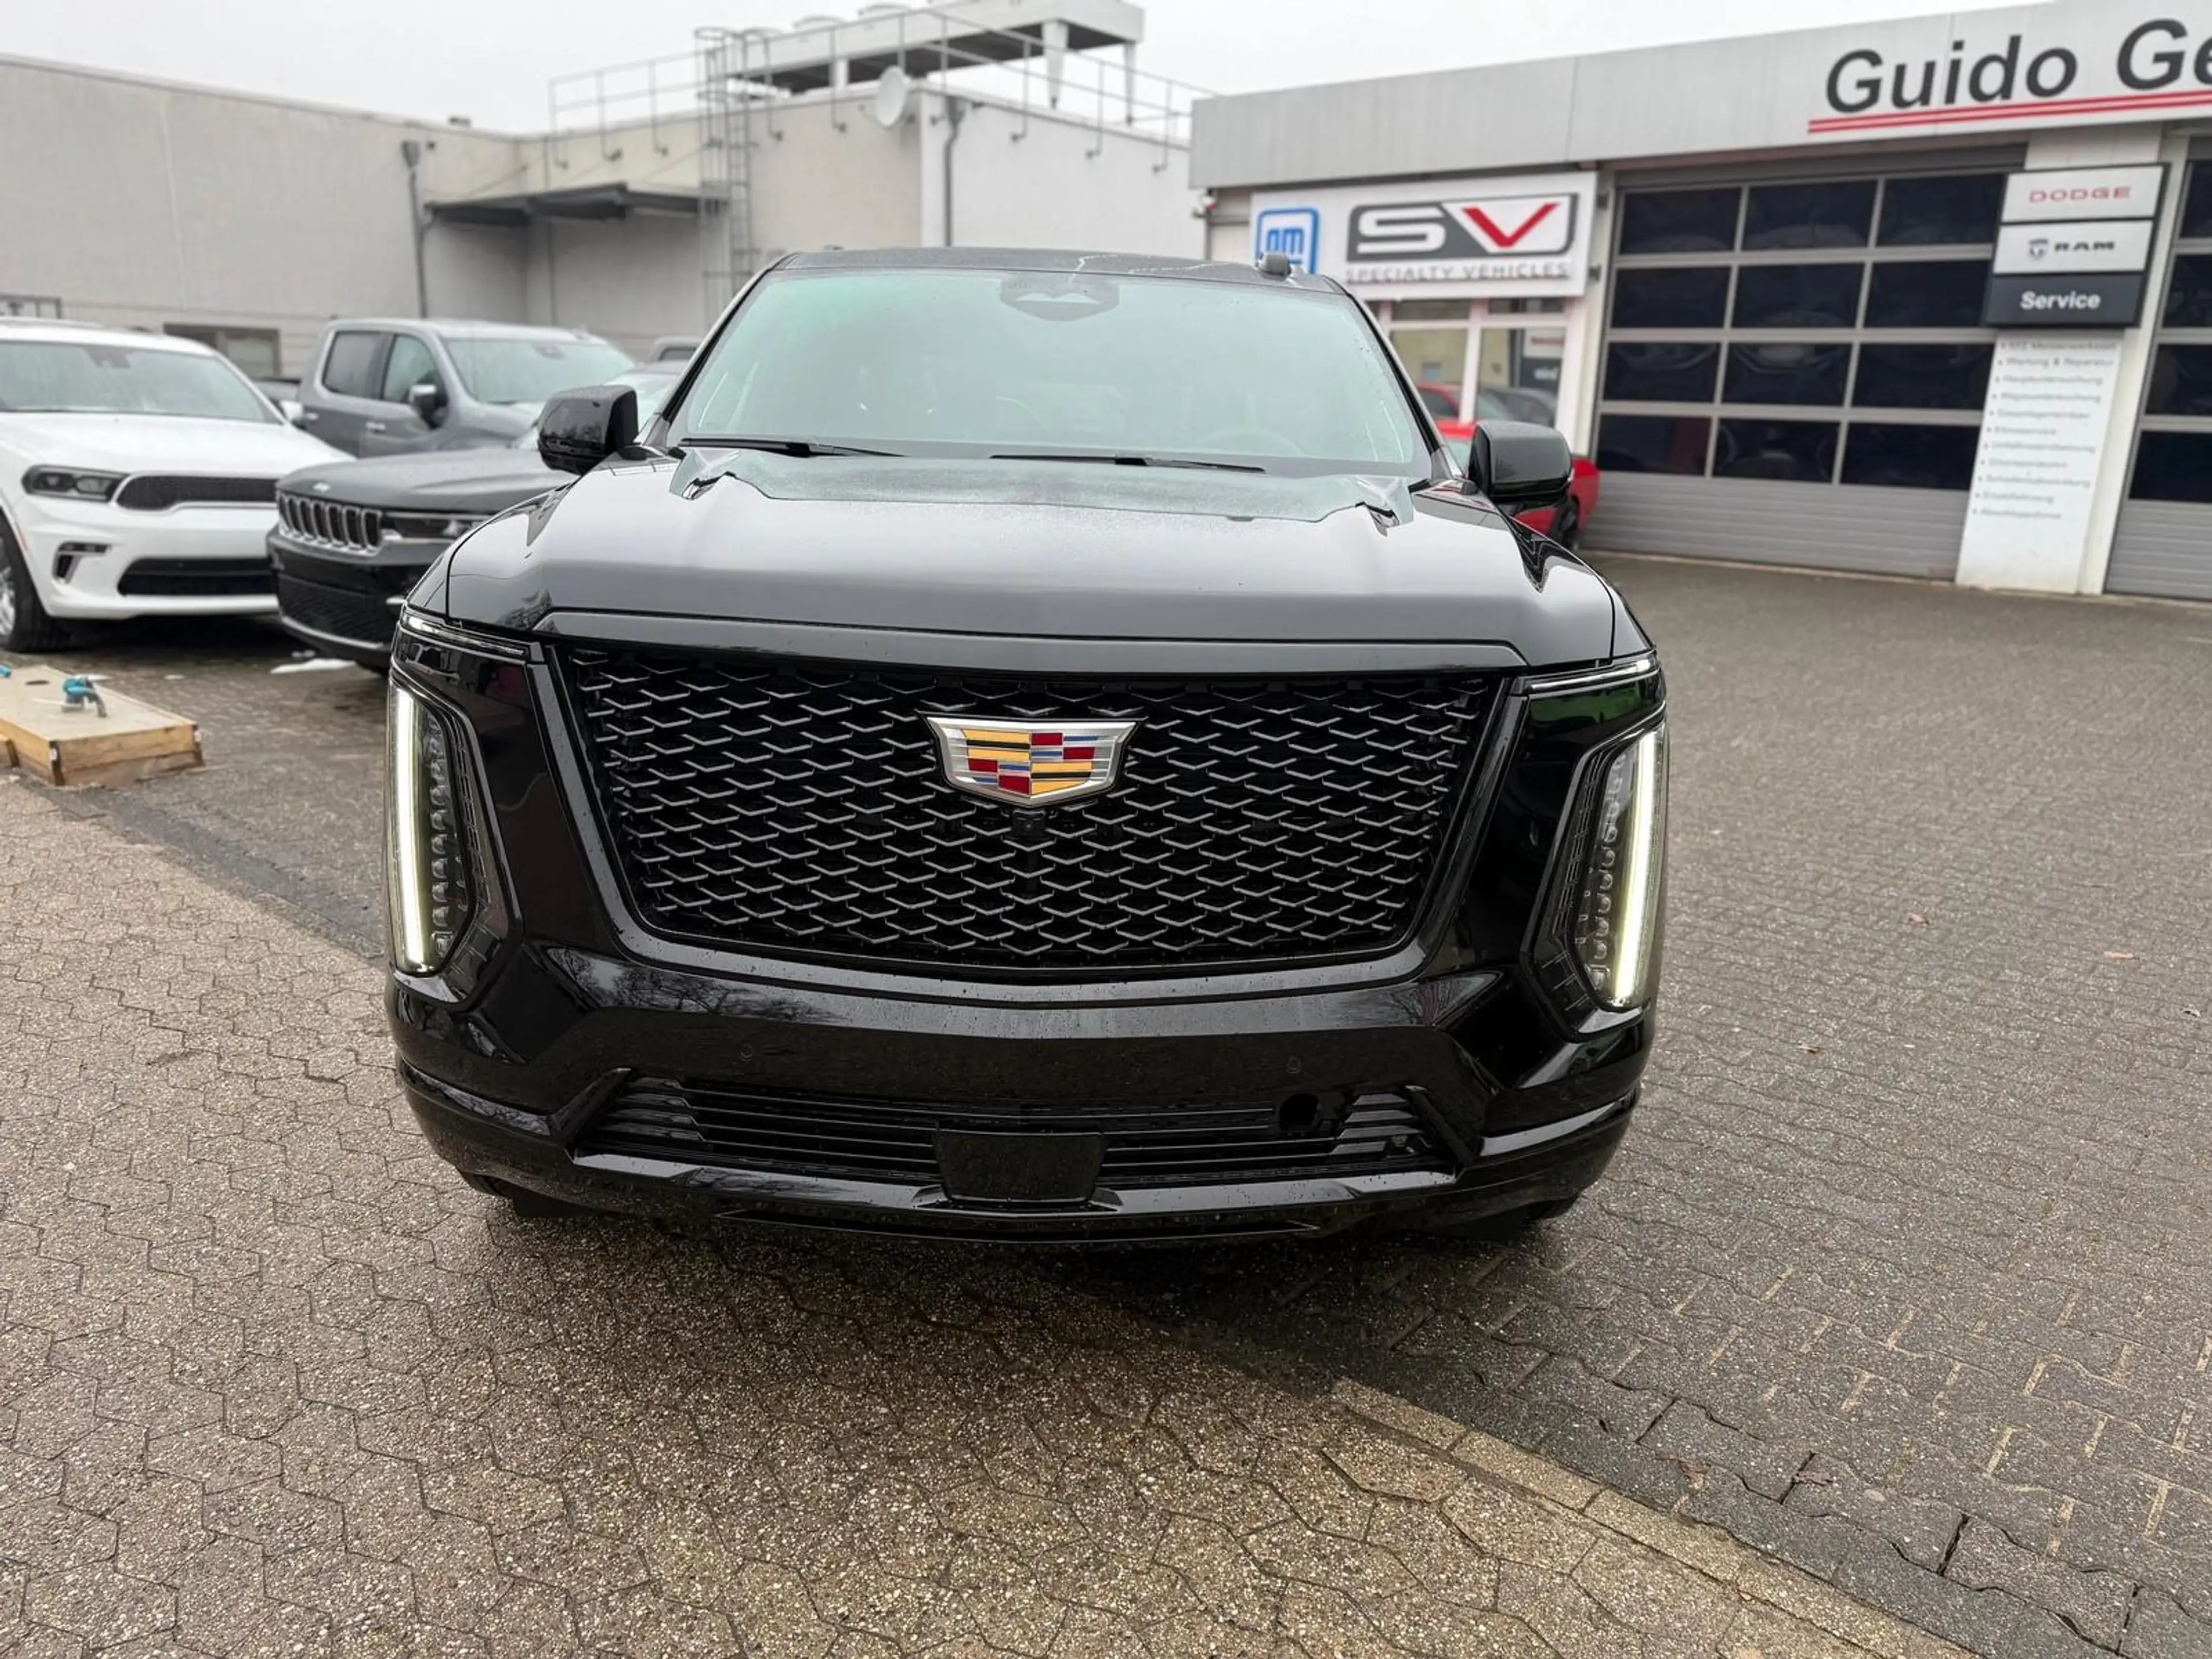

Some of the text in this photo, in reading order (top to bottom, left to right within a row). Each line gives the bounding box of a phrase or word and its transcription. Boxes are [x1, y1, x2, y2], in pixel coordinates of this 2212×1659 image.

[1825, 34, 2078, 113] Guido
[2029, 187, 2131, 203] DODGE
[1356, 201, 1562, 255] SV
[2055, 240, 2115, 252] RAM
[1346, 261, 1569, 284] SPECIALTY VEHICLES
[2020, 290, 2101, 310] Service
